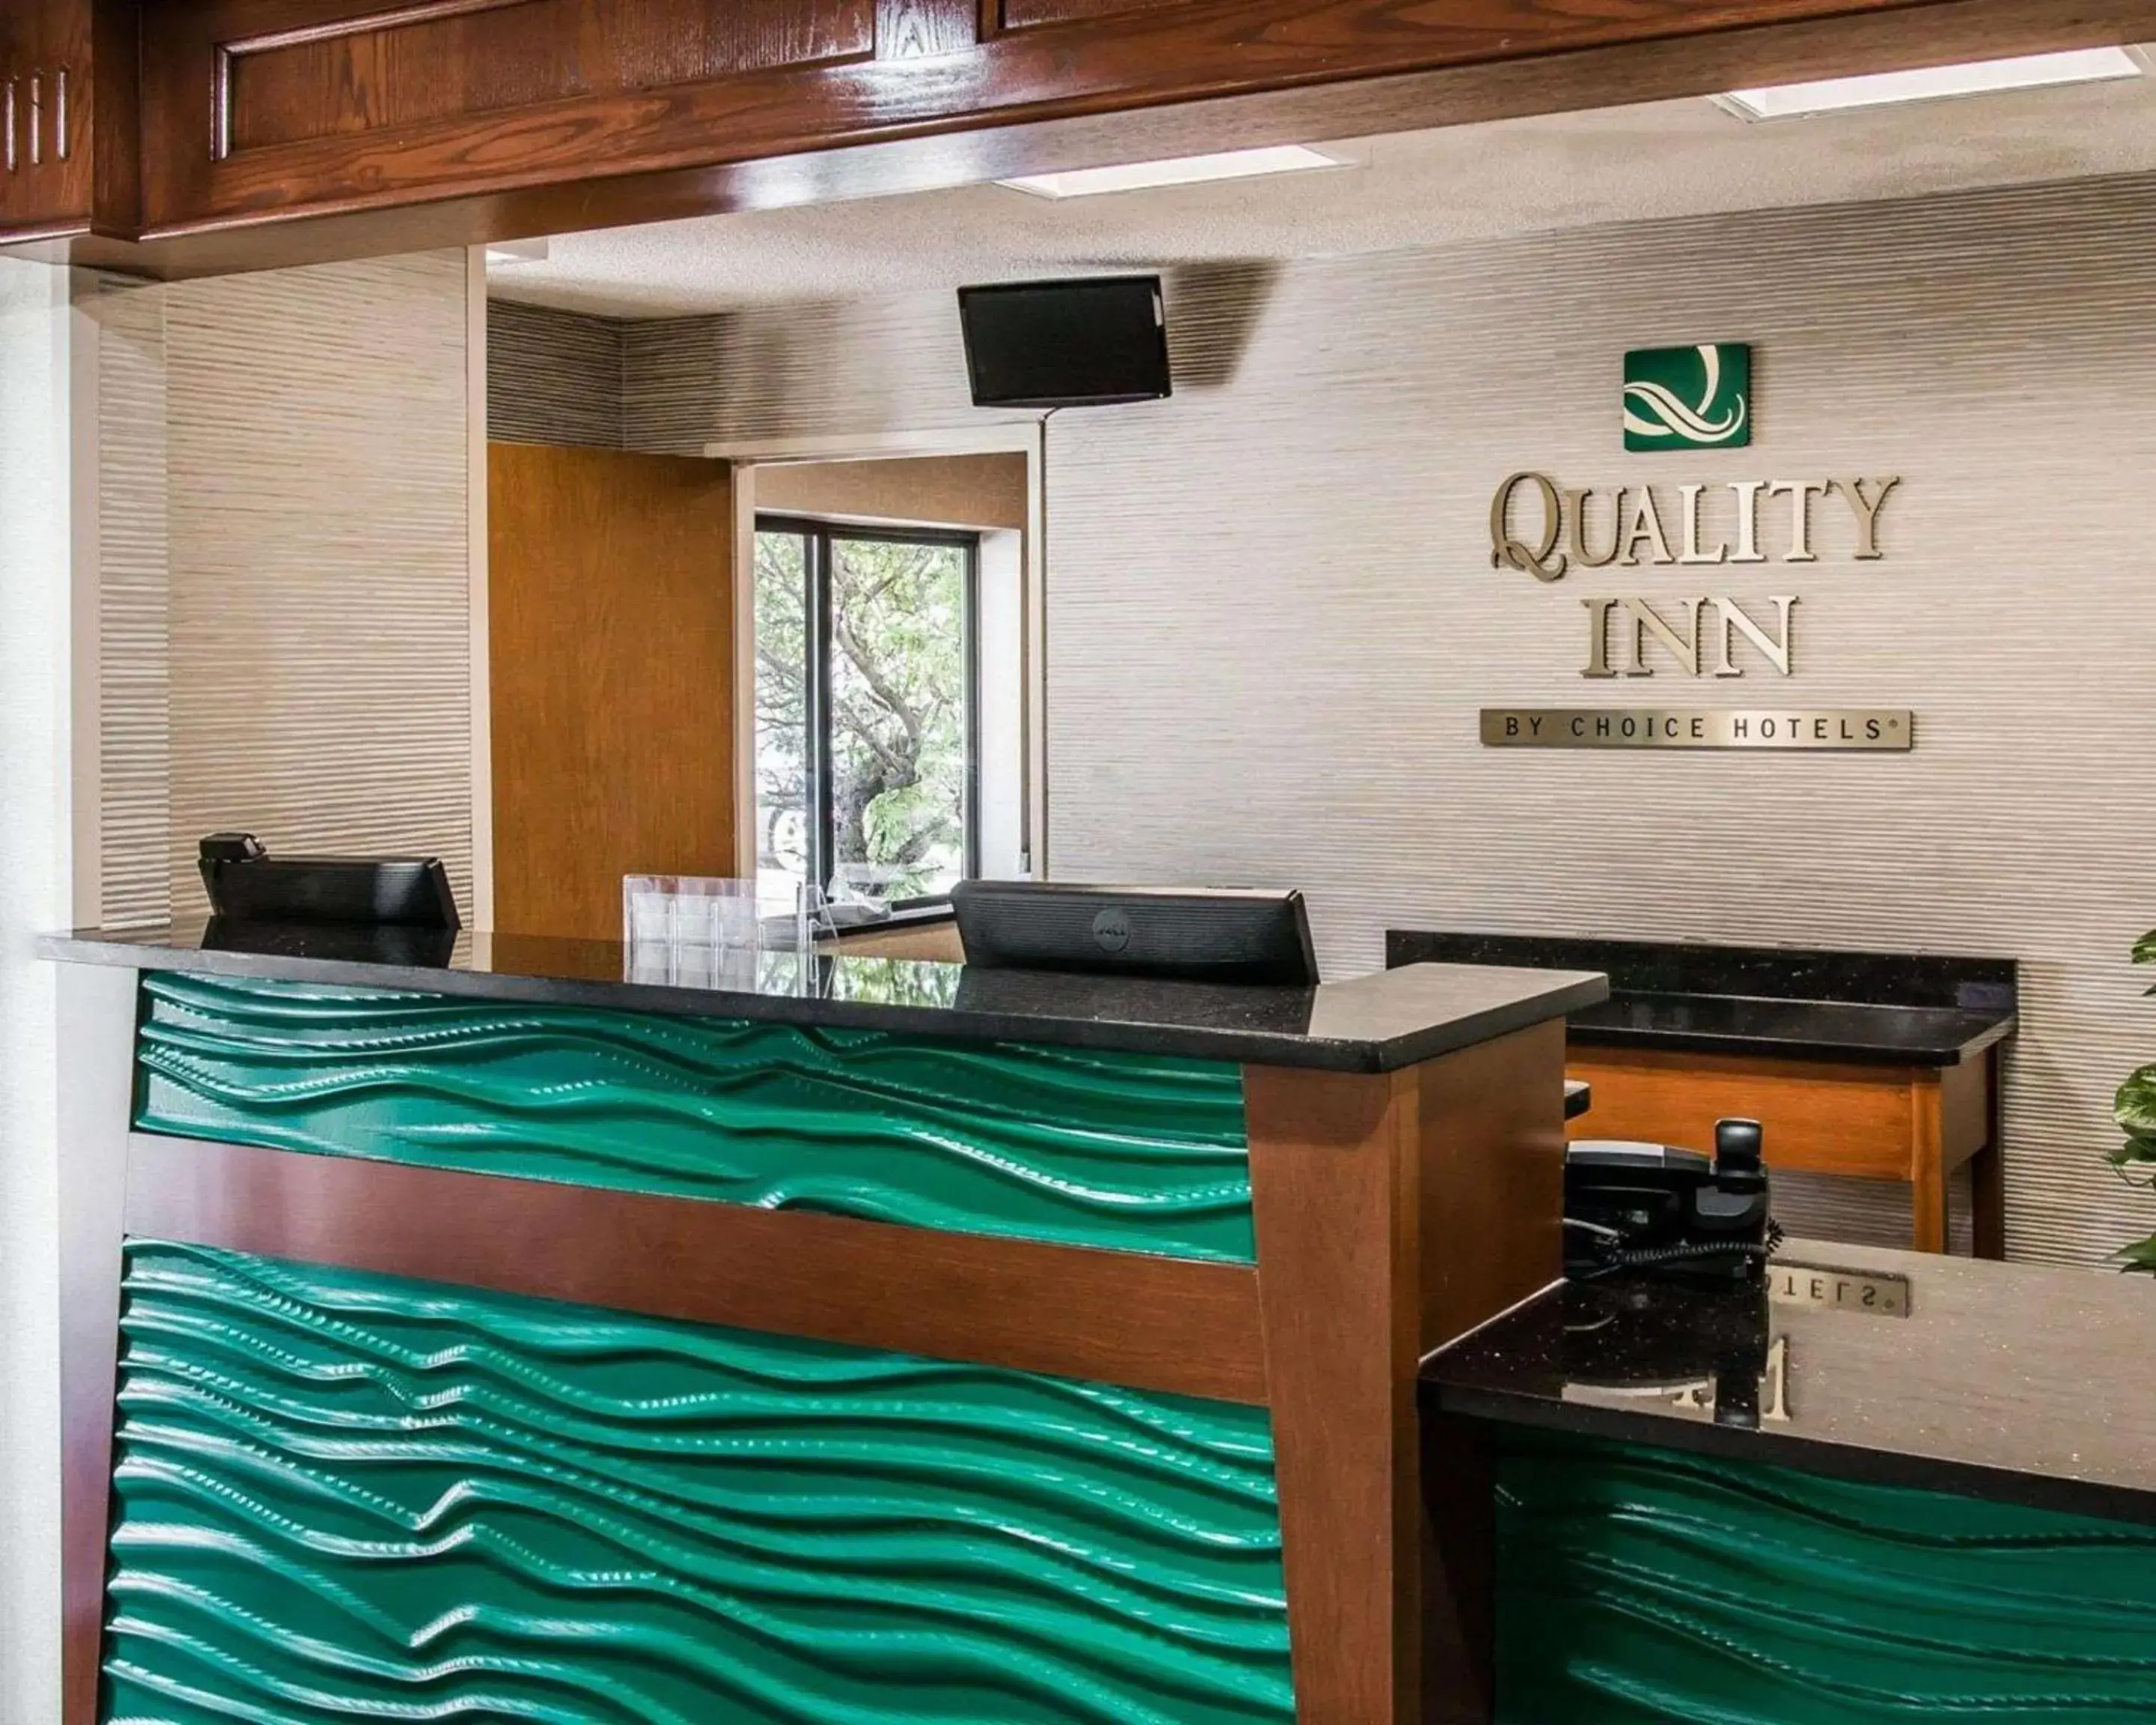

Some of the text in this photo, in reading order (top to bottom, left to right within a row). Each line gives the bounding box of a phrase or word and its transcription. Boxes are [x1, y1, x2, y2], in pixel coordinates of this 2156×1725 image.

[1490, 472, 1900, 581] QUALITY
[1580, 596, 1799, 678] INN
[1505, 717, 1543, 737] BY
[1571, 717, 1705, 738] CHOICE
